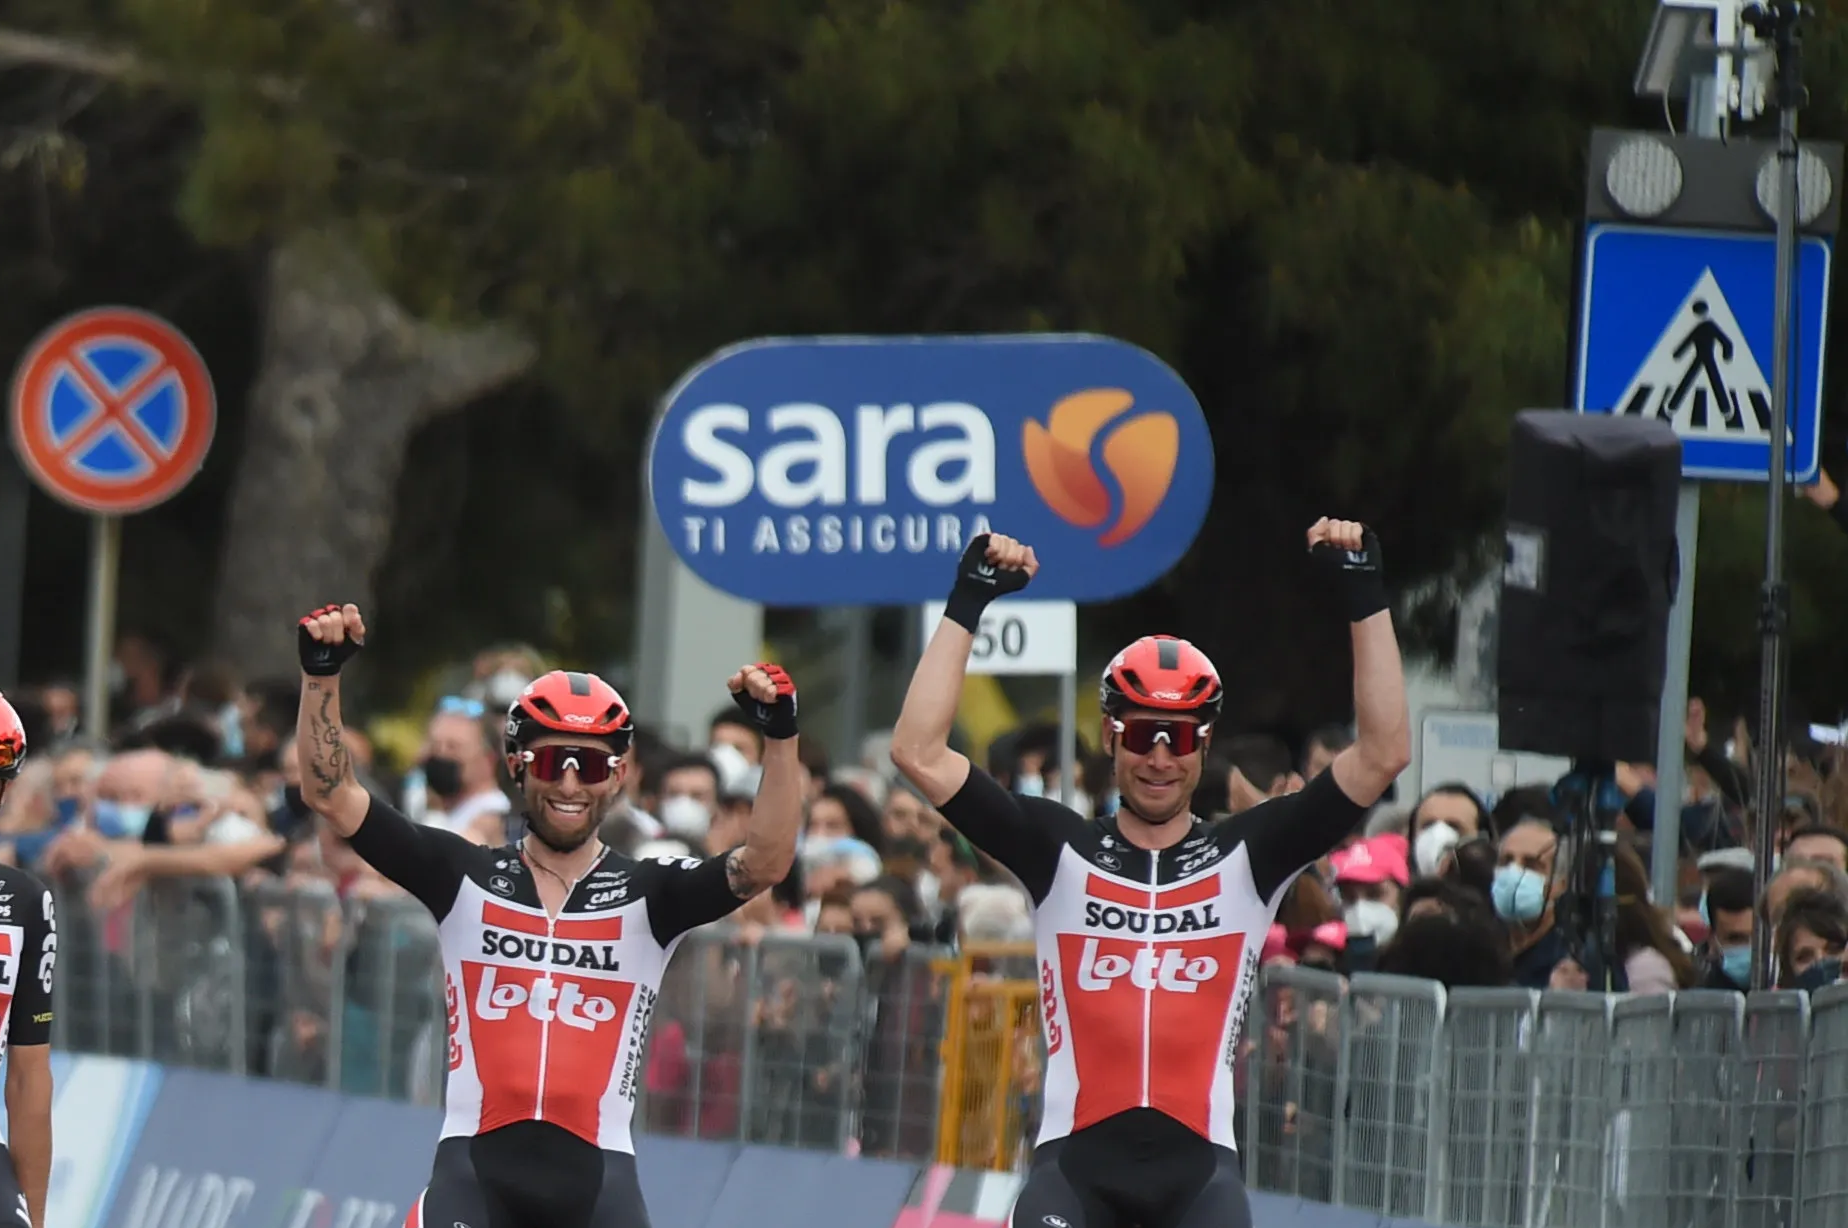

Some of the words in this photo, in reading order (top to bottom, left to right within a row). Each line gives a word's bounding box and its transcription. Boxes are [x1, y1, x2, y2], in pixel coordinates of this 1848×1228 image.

[680, 401, 998, 508] sara
[683, 516, 726, 553] TI
[590, 886, 628, 904] CAPS
[1084, 901, 1221, 935] SOUDAL
[481, 929, 620, 971] SOUDAL
[629, 982, 648, 1033] SEALS
[618, 1050, 634, 1098] BONDS
